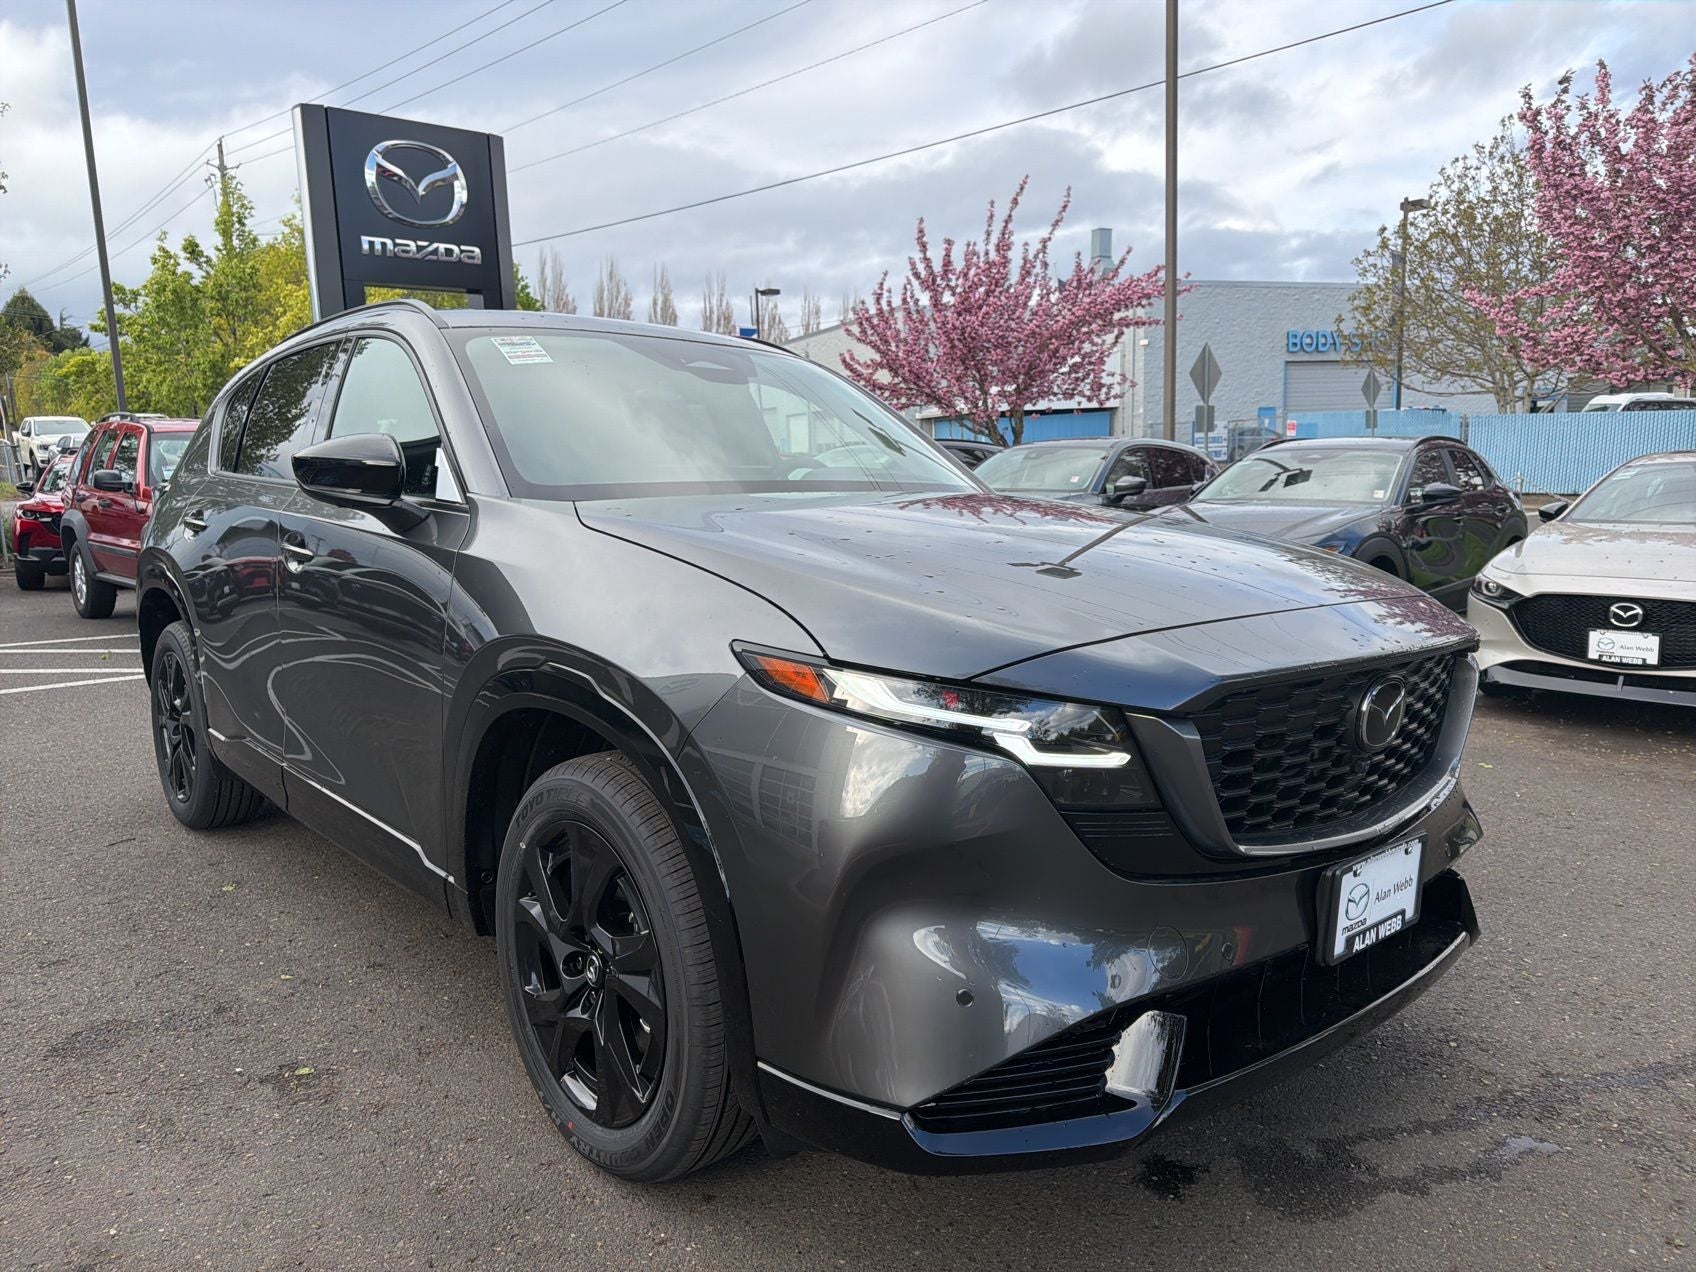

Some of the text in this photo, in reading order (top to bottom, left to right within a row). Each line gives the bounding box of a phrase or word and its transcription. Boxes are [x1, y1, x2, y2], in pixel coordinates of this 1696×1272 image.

[1287, 330, 1340, 353] BODY
[1602, 655, 1620, 663] ALAN
[1374, 875, 1413, 905] Alan Webb
[1352, 914, 1402, 953] ALAN WEBB
